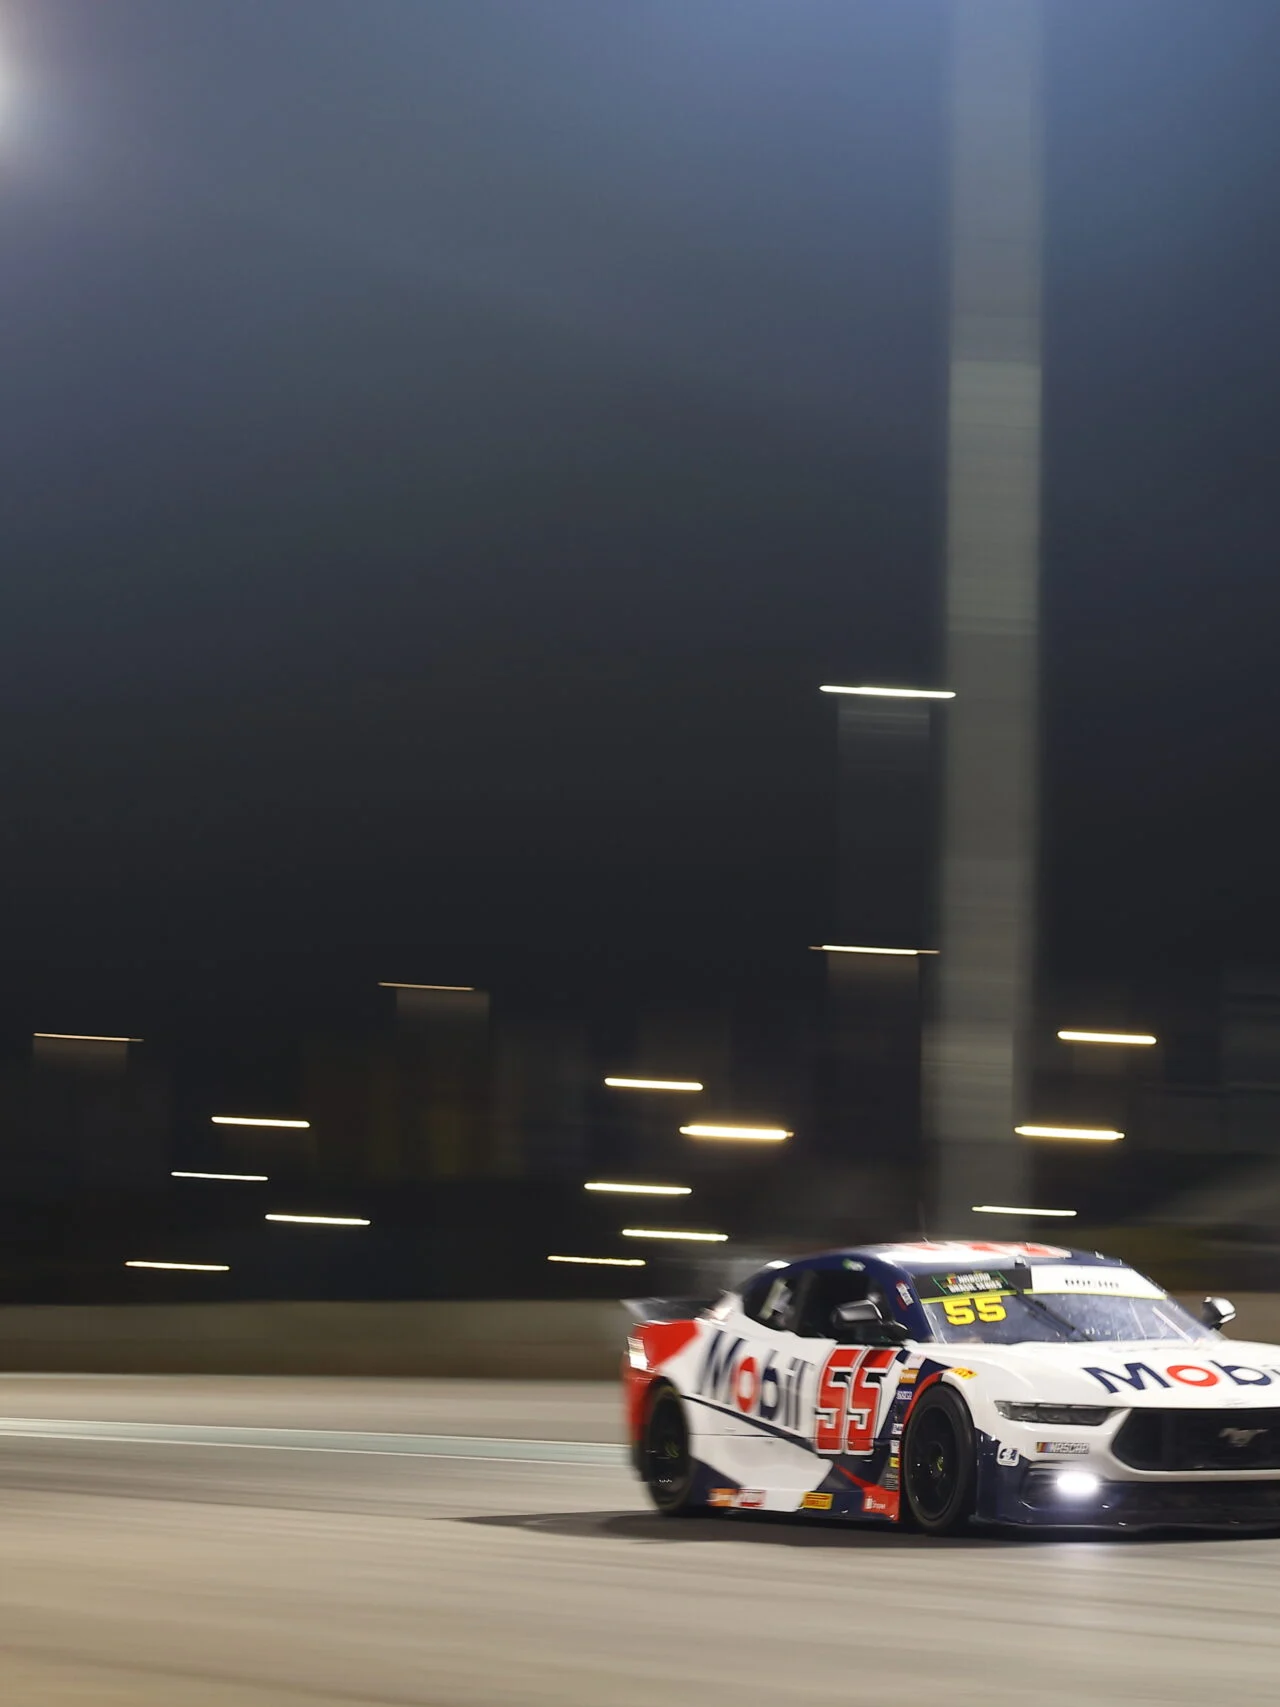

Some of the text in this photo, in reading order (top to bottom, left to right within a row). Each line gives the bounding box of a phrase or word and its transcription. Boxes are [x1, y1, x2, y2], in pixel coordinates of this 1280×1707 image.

[942, 1296, 1007, 1325] 55
[697, 1330, 811, 1431] Mobil
[814, 1346, 902, 1455] 55
